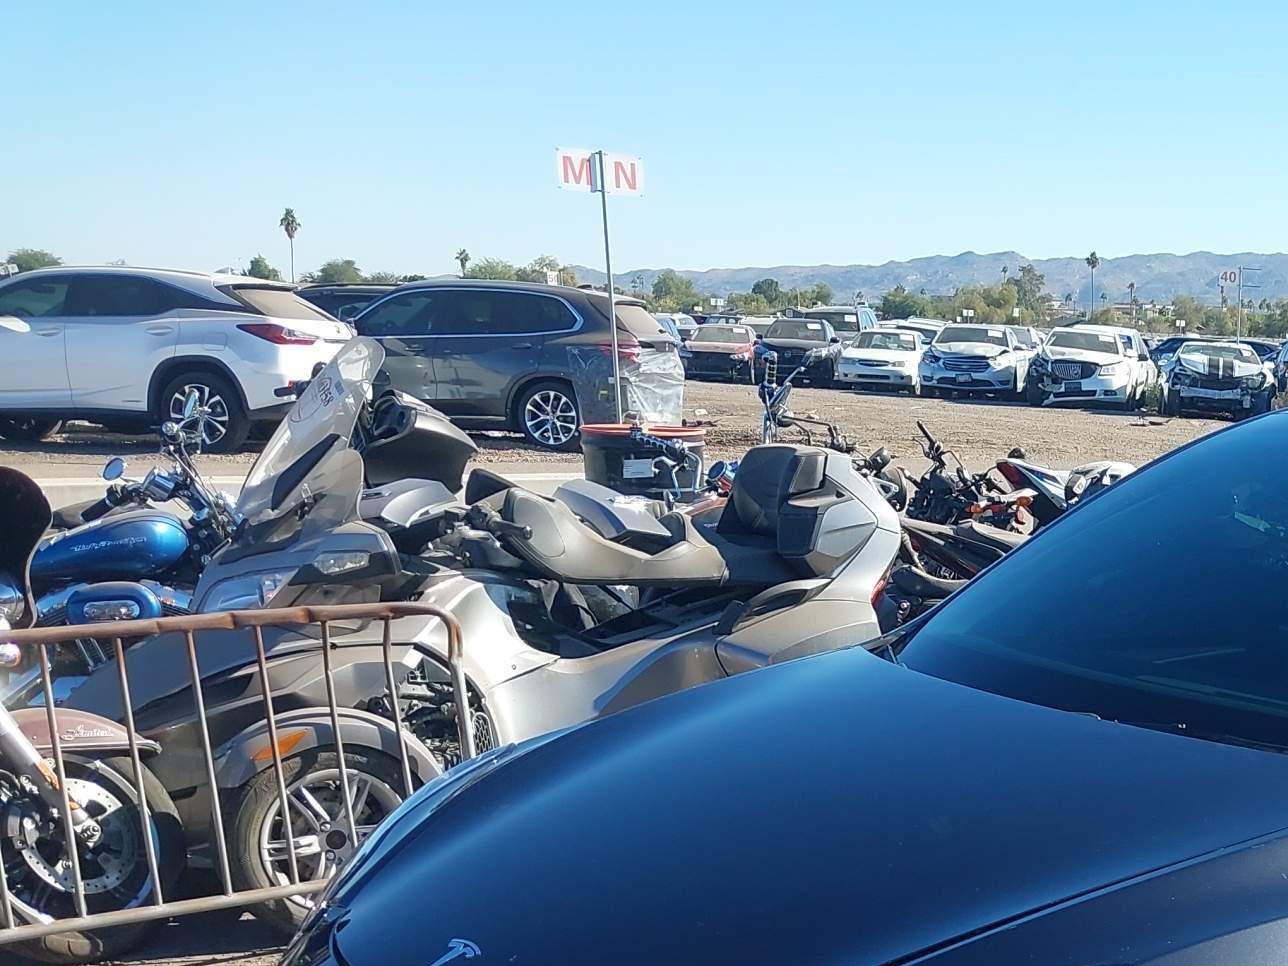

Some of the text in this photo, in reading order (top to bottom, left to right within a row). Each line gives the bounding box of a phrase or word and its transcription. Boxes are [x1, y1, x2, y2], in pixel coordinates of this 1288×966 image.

[562, 155, 592, 186] M
[614, 160, 637, 190] N
[1220, 271, 1237, 283] 40
